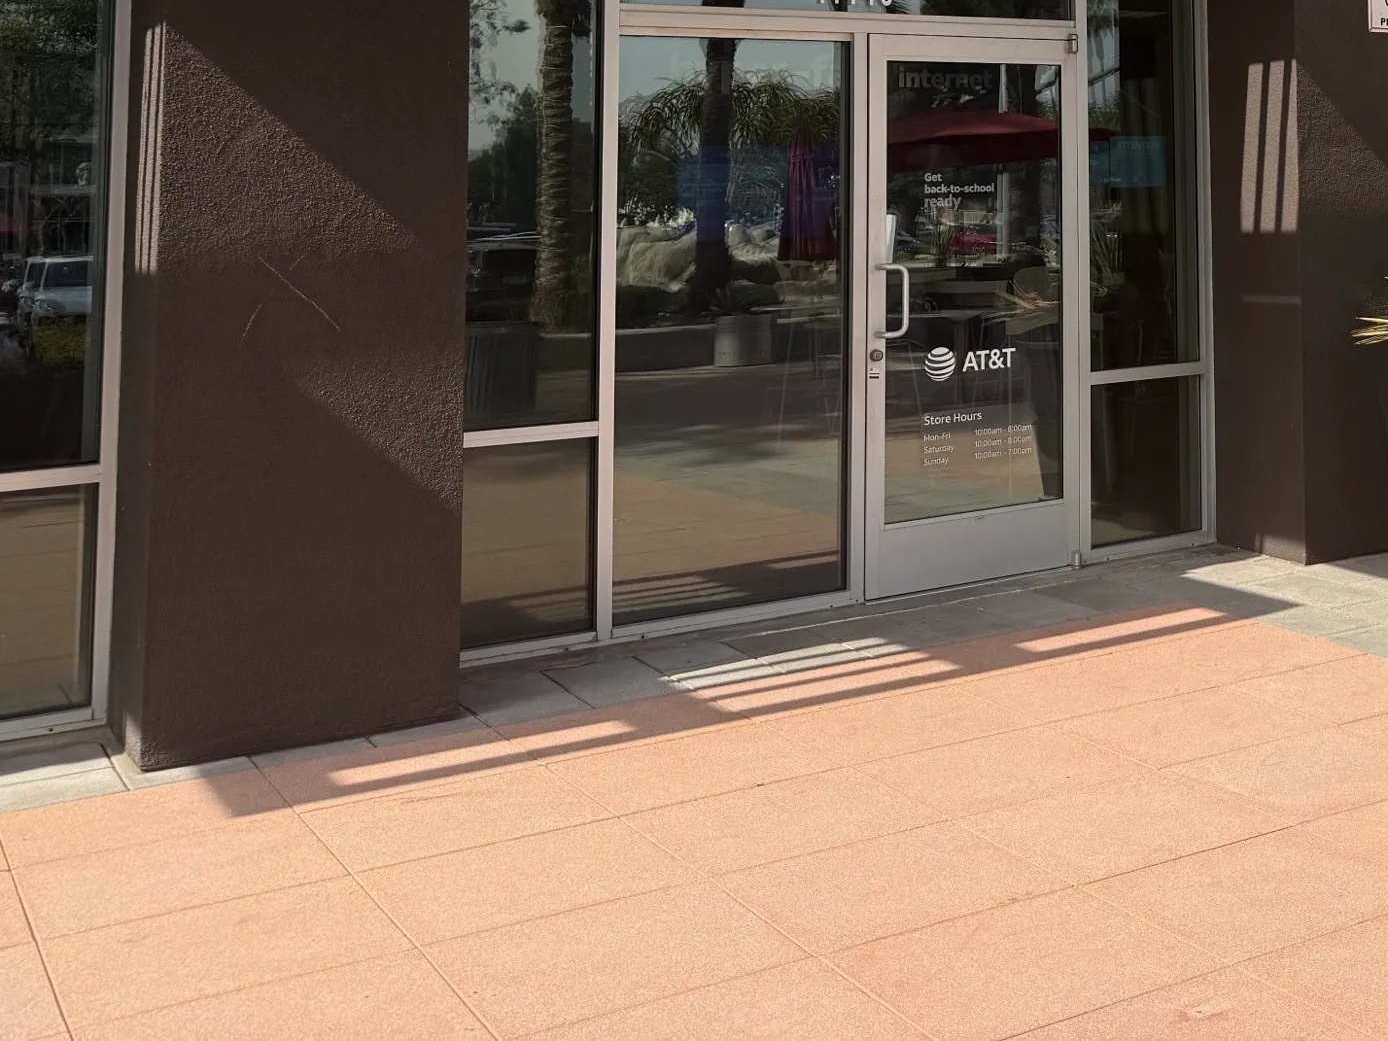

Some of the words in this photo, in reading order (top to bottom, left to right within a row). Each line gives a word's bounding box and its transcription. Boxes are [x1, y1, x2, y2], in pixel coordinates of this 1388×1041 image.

[898, 66, 993, 89] internet
[924, 173, 942, 182] Get
[924, 183, 995, 194] back-to-school
[924, 194, 962, 211] ready
[962, 347, 1016, 372] AT&T
[924, 415, 951, 426] Store
[953, 412, 982, 423] Hours
[923, 432, 951, 442] Mon-Fri
[974, 427, 1002, 436] 10:00am
[923, 444, 955, 454] Saturday
[974, 439, 1002, 448] 10:00am
[923, 457, 950, 466] Sunday
[974, 450, 1002, 459] 10:00am
